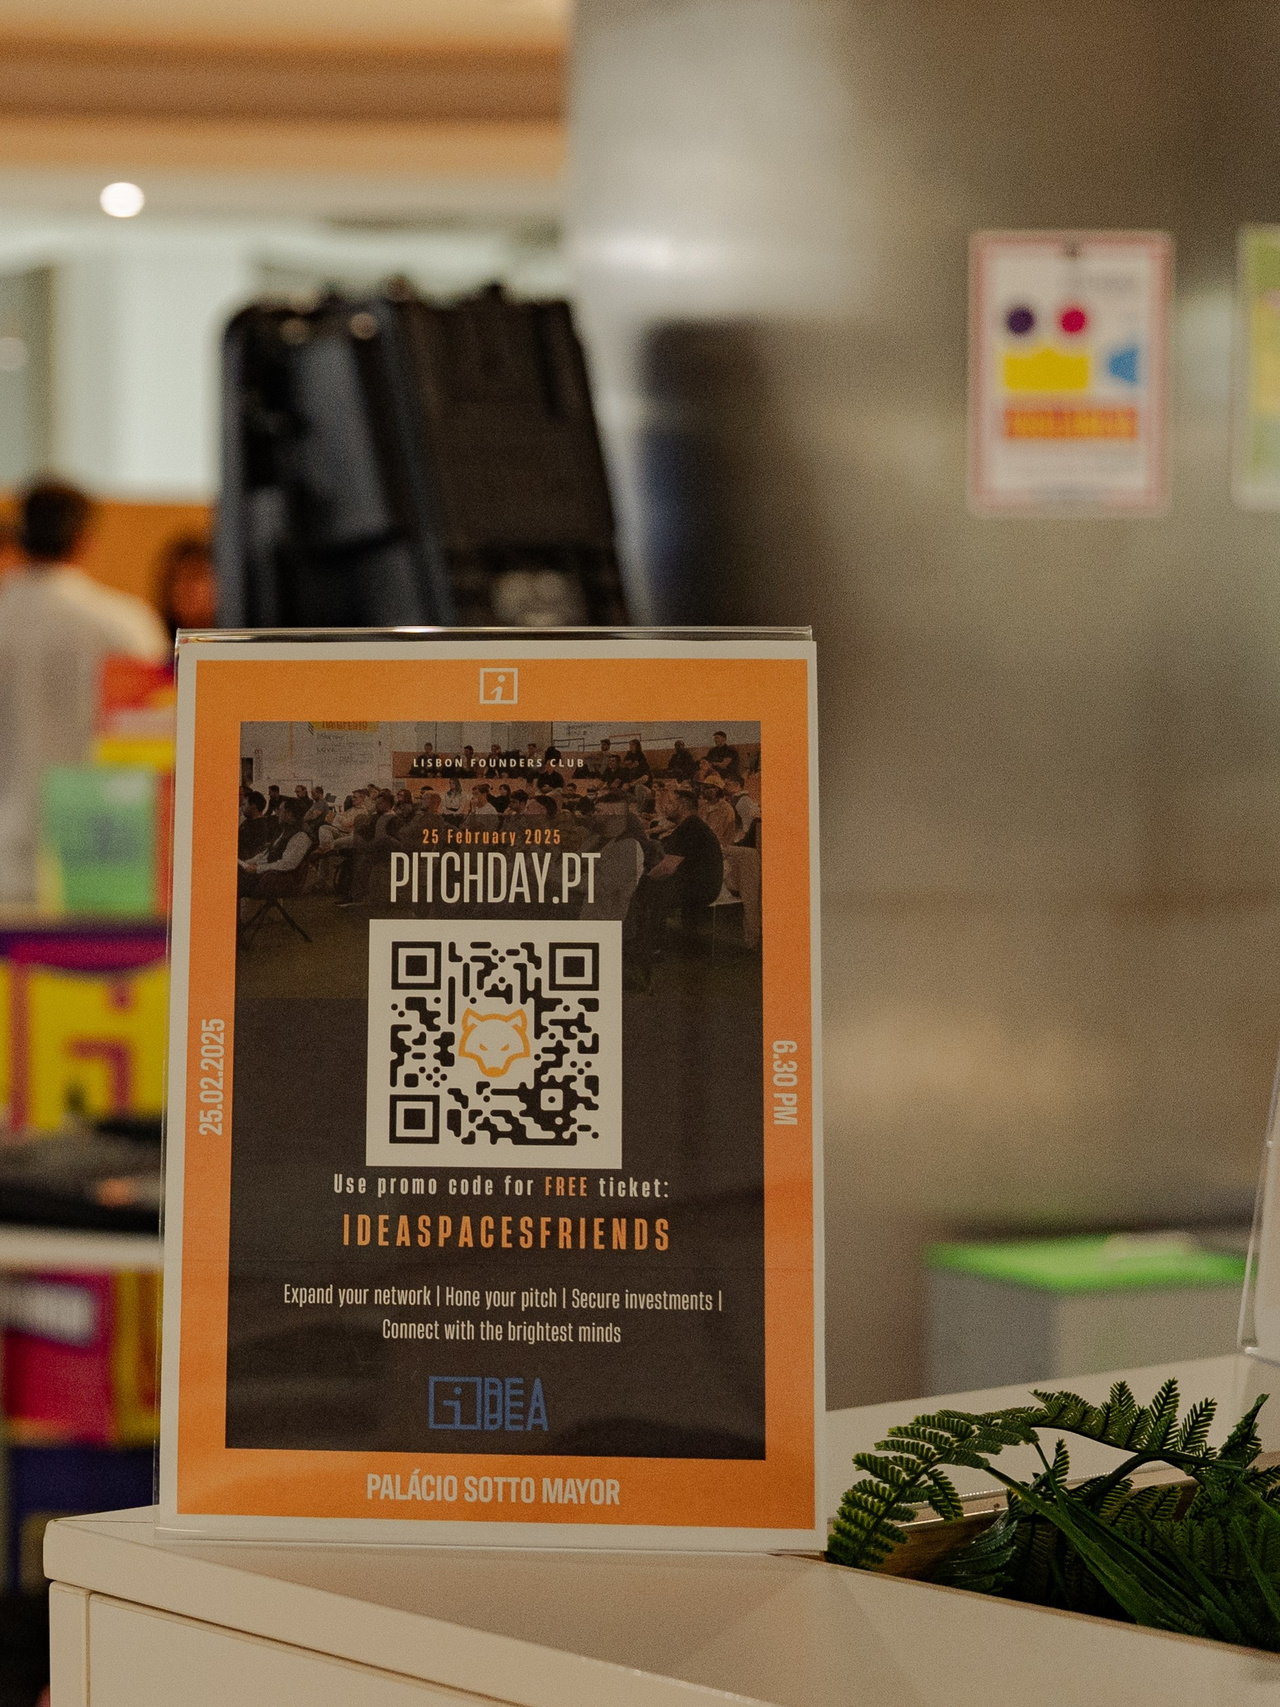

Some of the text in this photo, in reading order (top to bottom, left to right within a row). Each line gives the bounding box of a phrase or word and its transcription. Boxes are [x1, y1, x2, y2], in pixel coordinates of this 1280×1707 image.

[413, 758, 584, 768] LISBON FOUNDERS CLUB
[422, 828, 561, 847] 25 February 2025
[390, 851, 601, 904] PITCHDAY.PT
[199, 1018, 225, 1136] 25.02.2025
[772, 1040, 798, 1126] 6.30 PM
[333, 1173, 669, 1198] Use promo code for FREE ticket:
[343, 1213, 669, 1251] IDEASPACESFRIENDS
[284, 1283, 333, 1308] Expand
[338, 1287, 369, 1308] your
[375, 1285, 432, 1306] network
[445, 1286, 480, 1307] Hone
[485, 1289, 516, 1310] your
[521, 1287, 557, 1311] pitch
[572, 1288, 620, 1309] Secure
[625, 1289, 713, 1311] investments
[382, 1318, 621, 1345] Connect with the brightest minds
[367, 1468, 620, 1505] PALÁCIO SOTTO MAYOR
